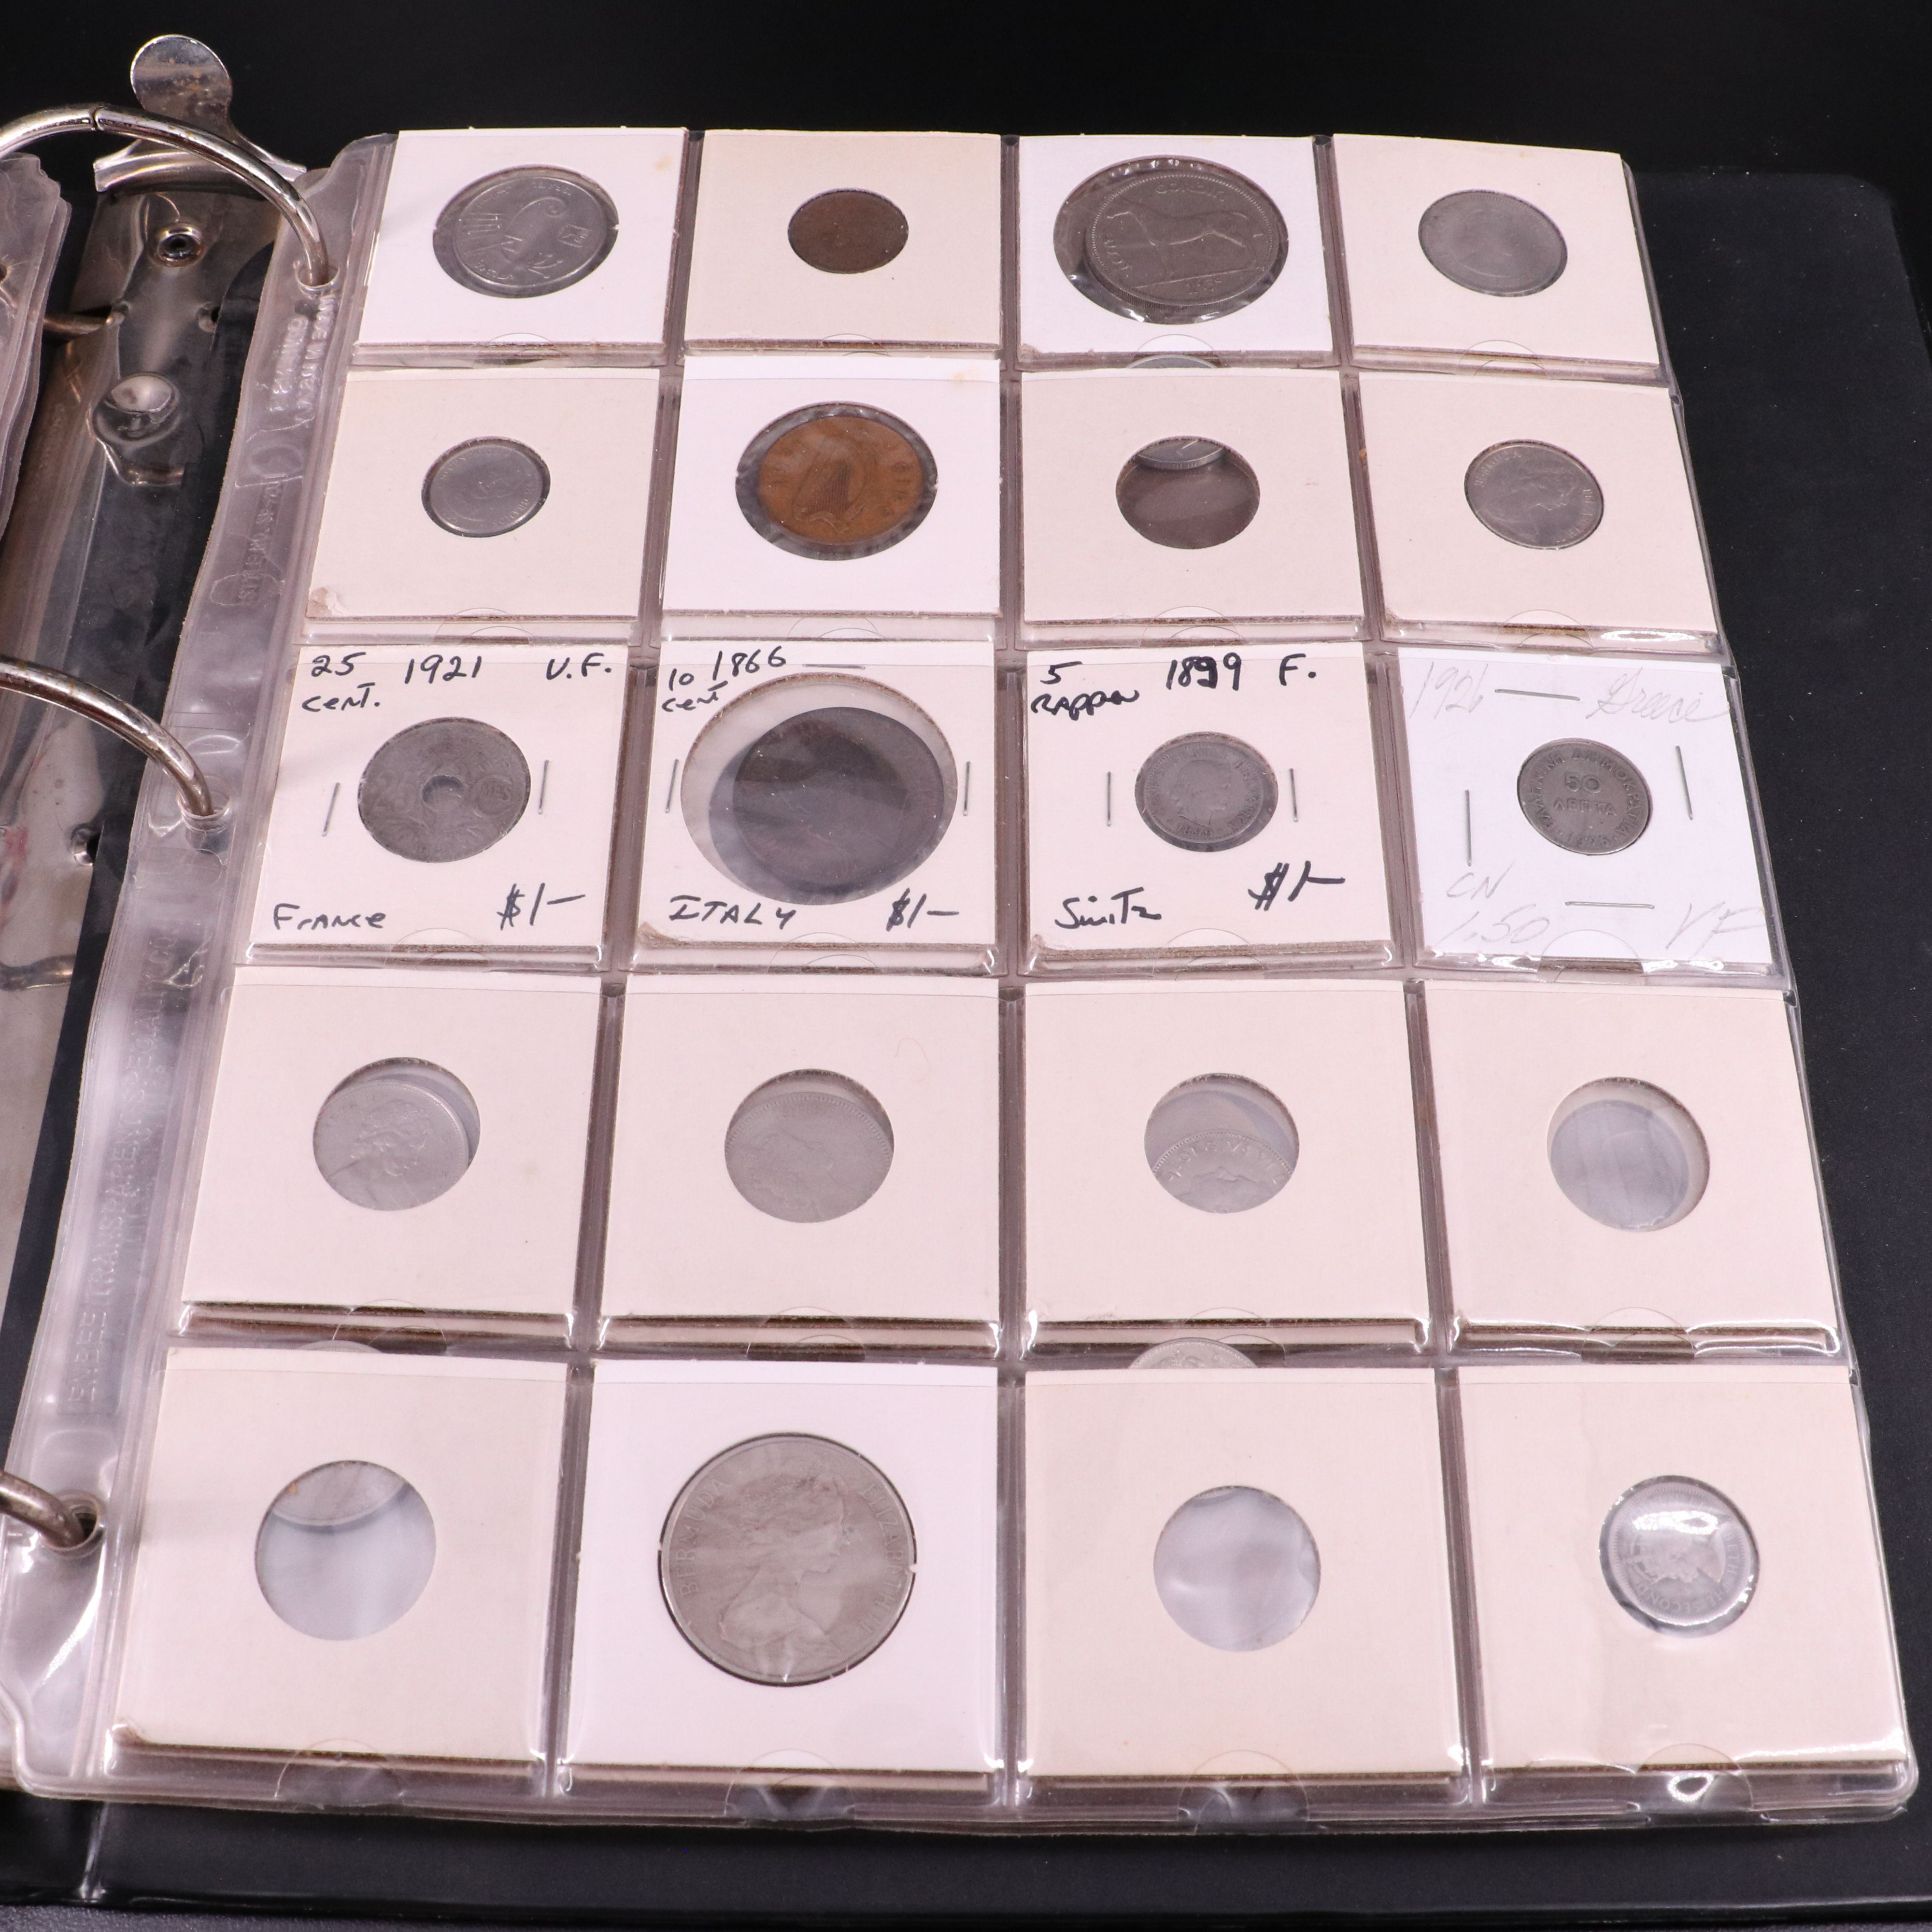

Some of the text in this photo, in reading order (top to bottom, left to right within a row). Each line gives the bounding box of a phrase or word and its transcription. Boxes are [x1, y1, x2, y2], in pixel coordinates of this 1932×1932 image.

[311, 652, 366, 677] 25
[404, 655, 482, 684] 1921
[712, 645, 786, 681] 1866
[1040, 661, 1083, 685] 5
[1279, 653, 1317, 686] F.
[668, 668, 694, 692] 10
[1564, 772, 1602, 793] 50
[669, 895, 796, 929] ITALY
[676, 1478, 733, 1597] BERMUDA
